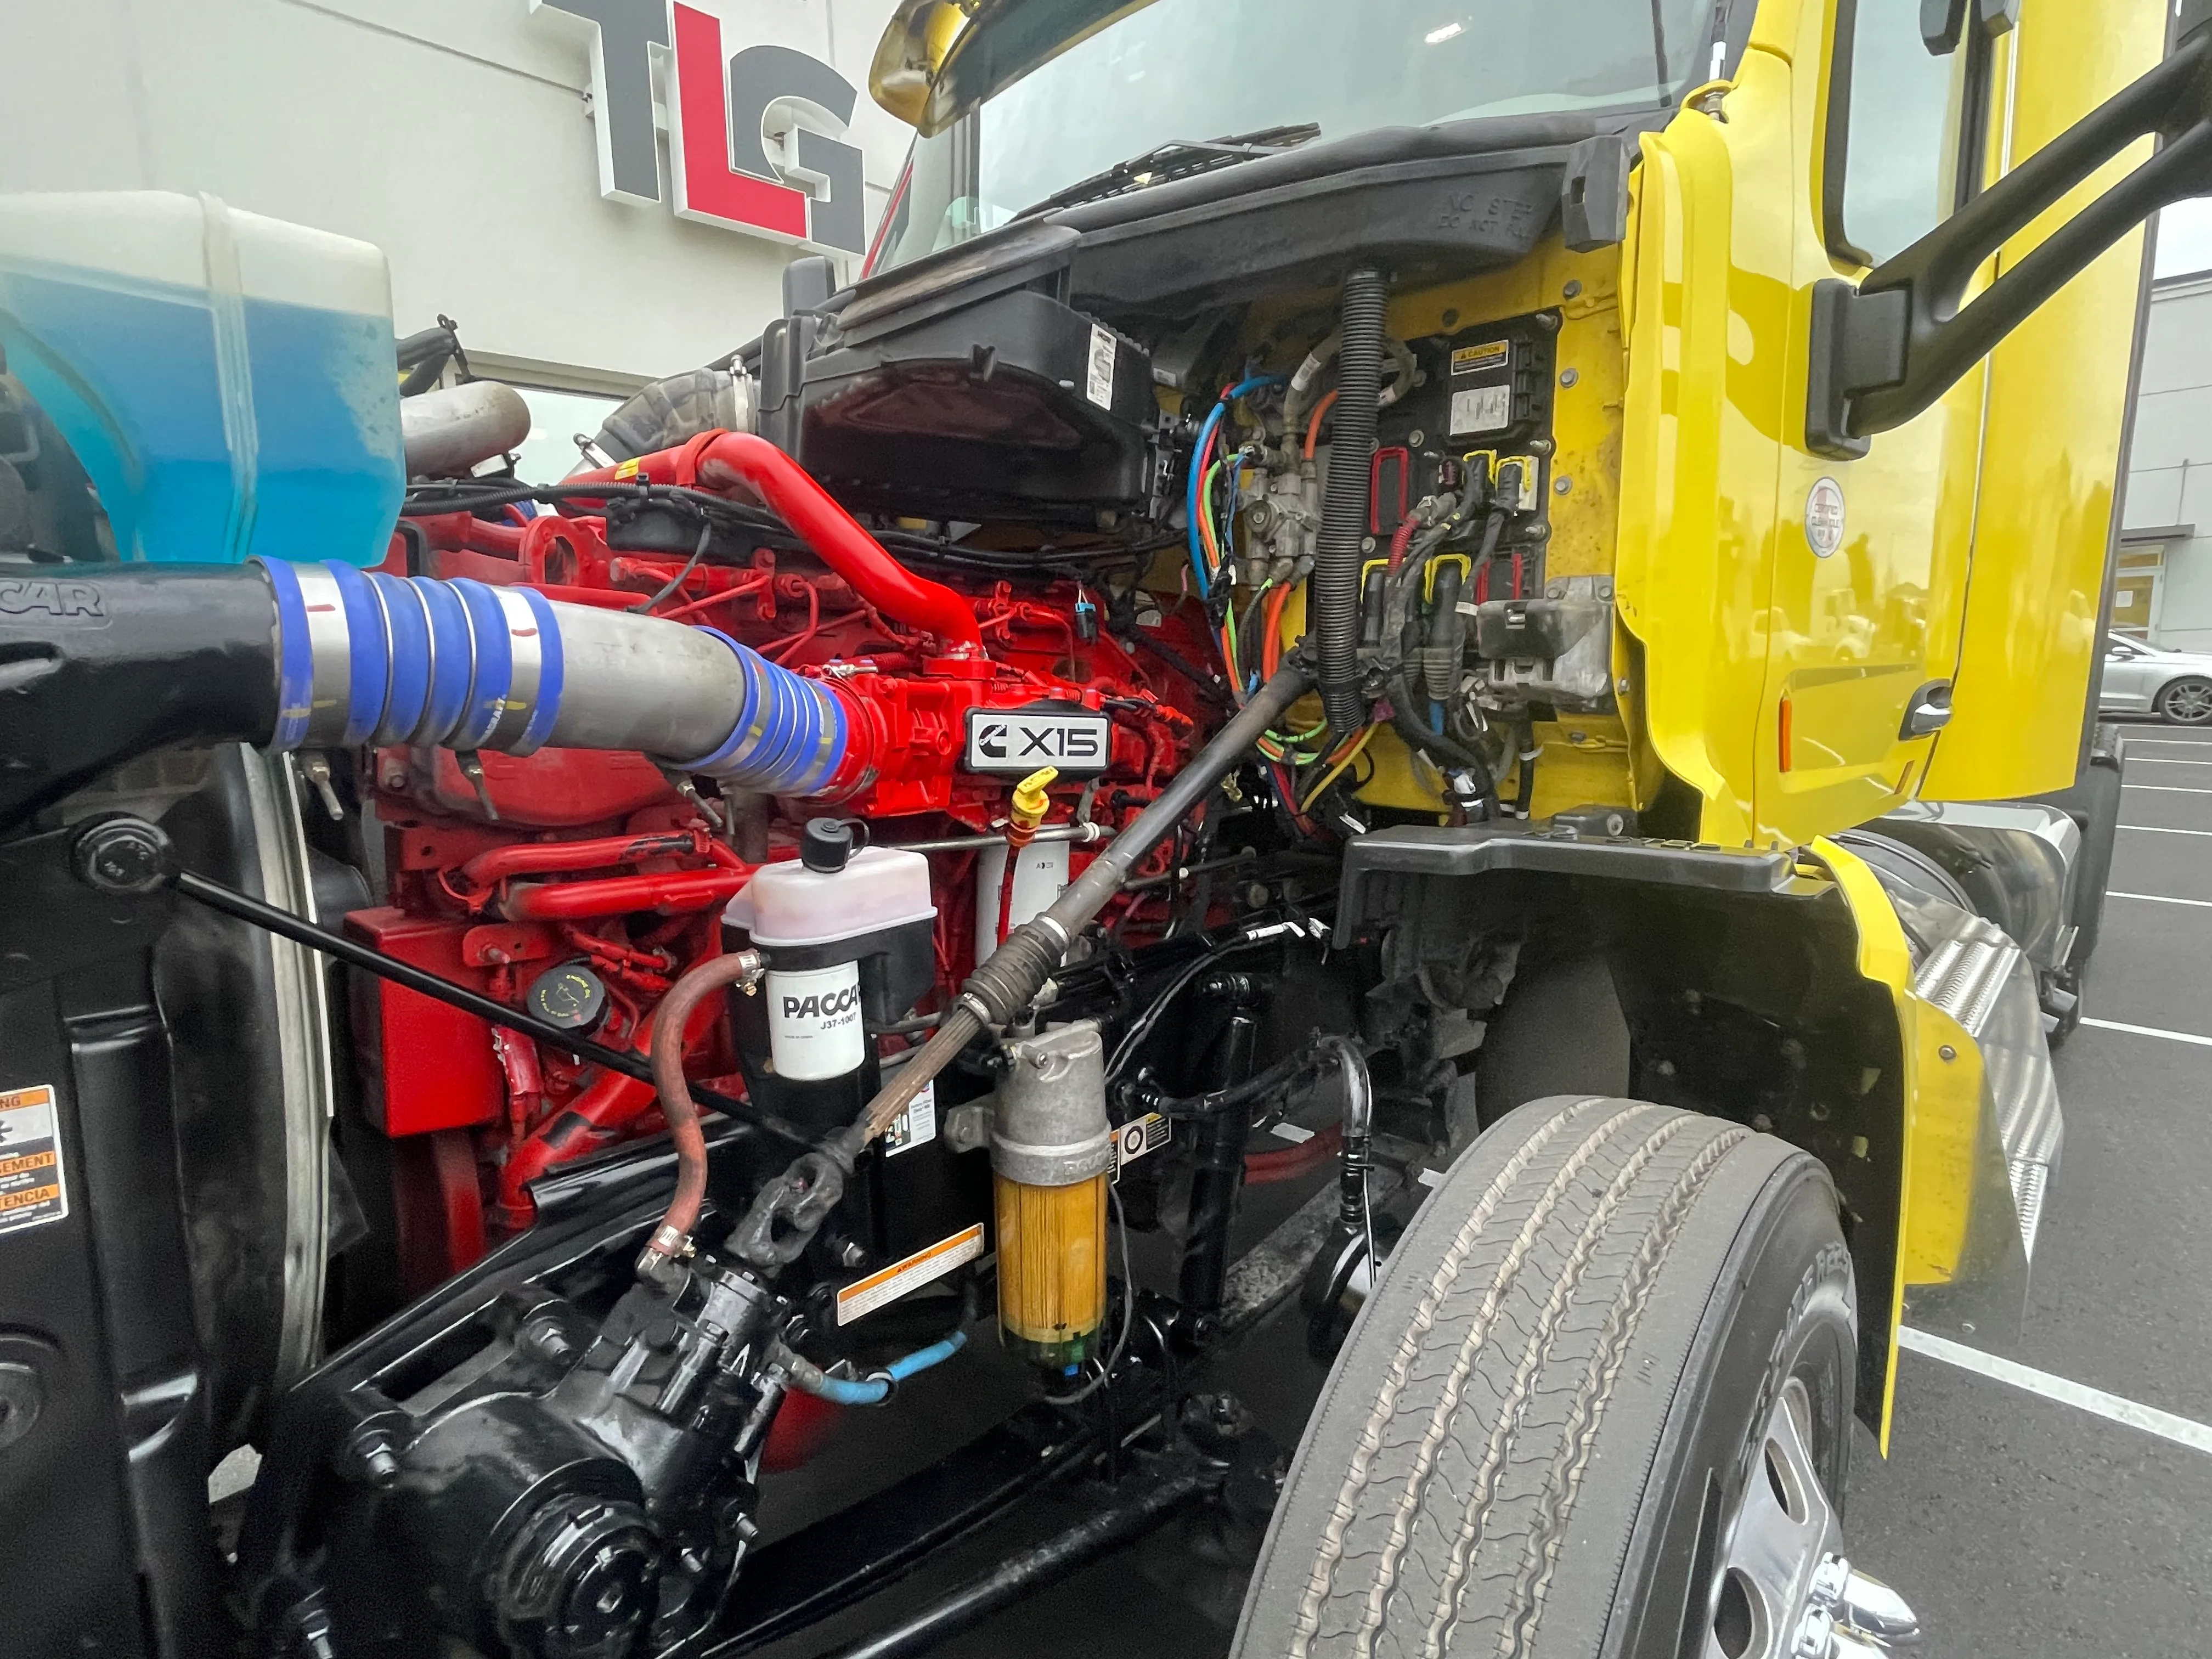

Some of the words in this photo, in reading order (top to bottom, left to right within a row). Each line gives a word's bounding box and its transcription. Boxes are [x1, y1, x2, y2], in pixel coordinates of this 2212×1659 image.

[530, 0, 866, 256] TLG
[1468, 346, 1499, 358] CAUTION
[1018, 727, 1098, 757] X15
[783, 984, 861, 1019] PACCA
[820, 1012, 856, 1030] J37-1007
